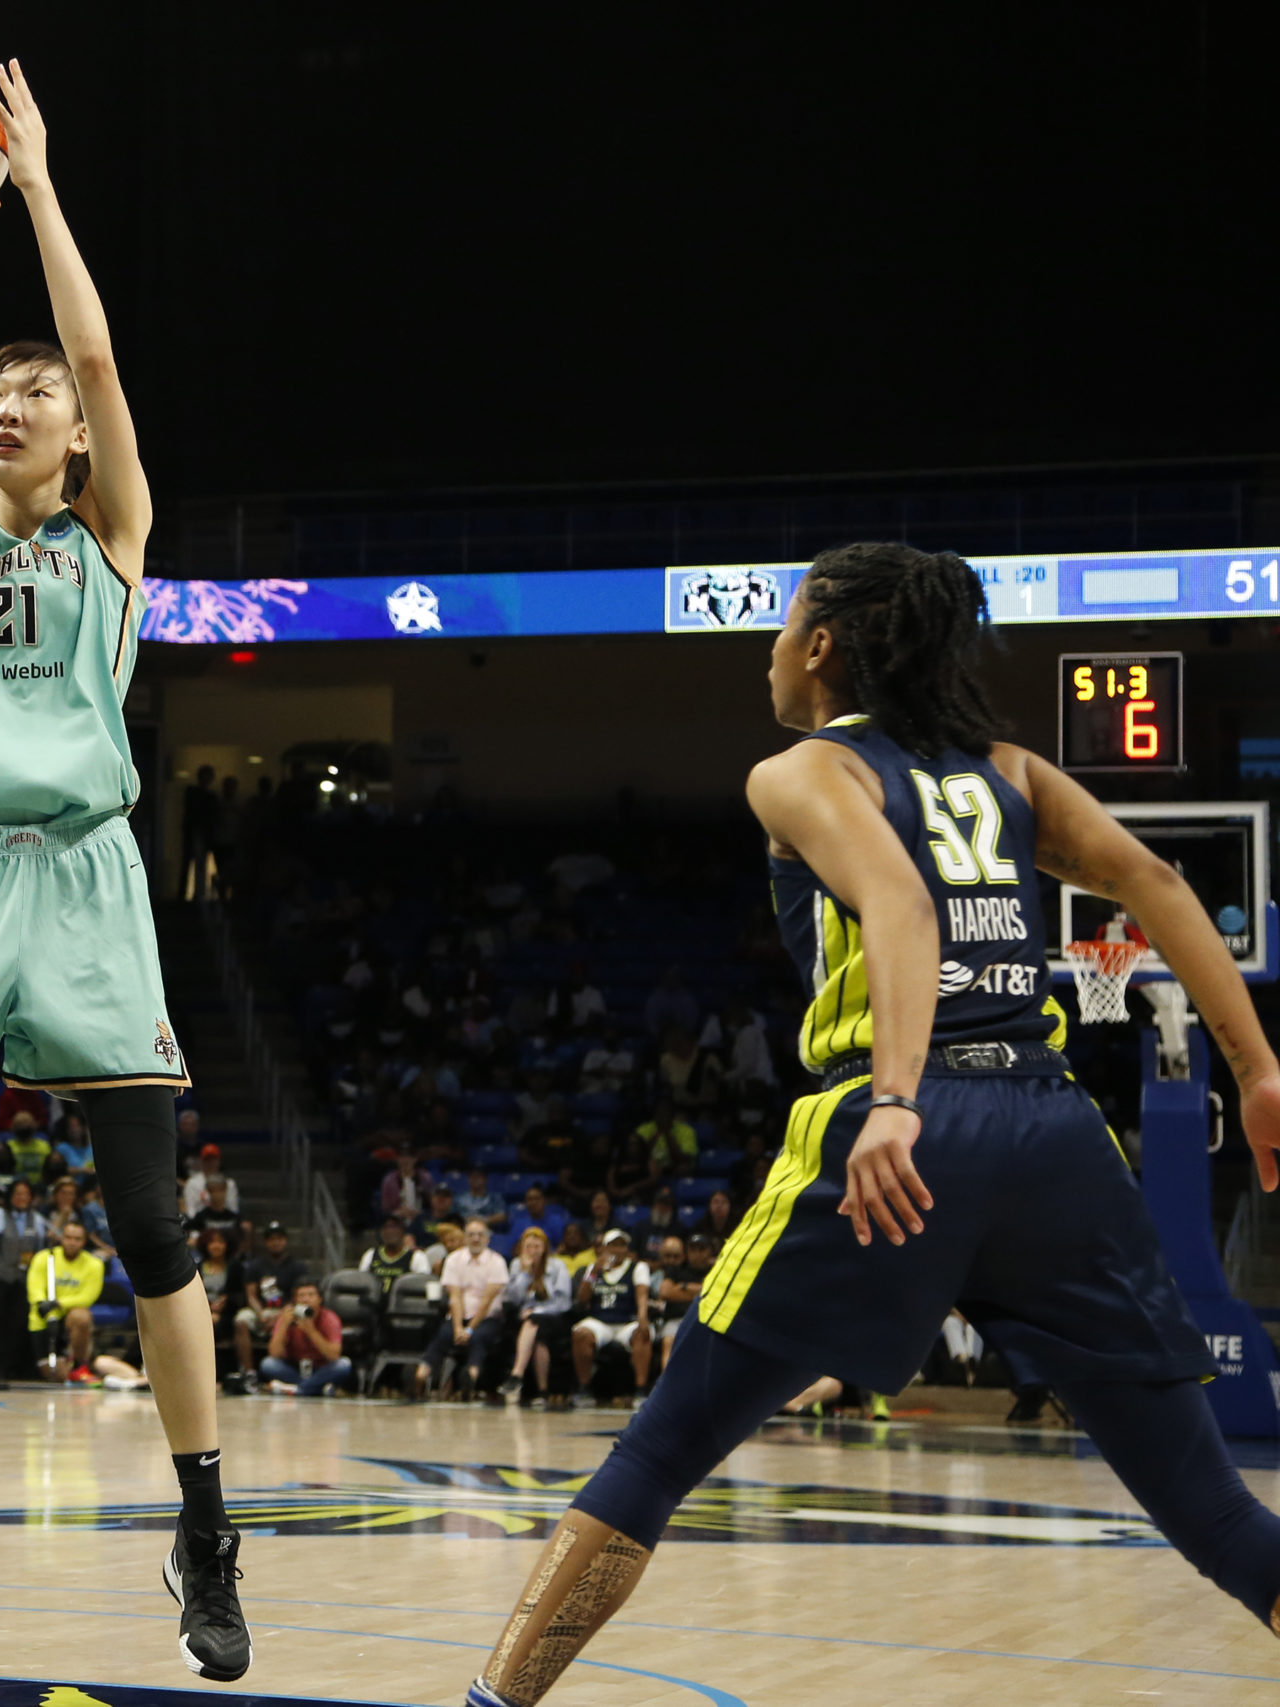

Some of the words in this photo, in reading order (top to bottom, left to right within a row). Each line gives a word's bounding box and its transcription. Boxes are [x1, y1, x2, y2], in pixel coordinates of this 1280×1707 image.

[1225, 559, 1279, 603] 51
[1, 661, 64, 680] Webull
[1124, 700, 1158, 759] 6
[910, 768, 1020, 886] 52
[947, 897, 1028, 942] HARRIS
[970, 963, 1038, 996] AT&T
